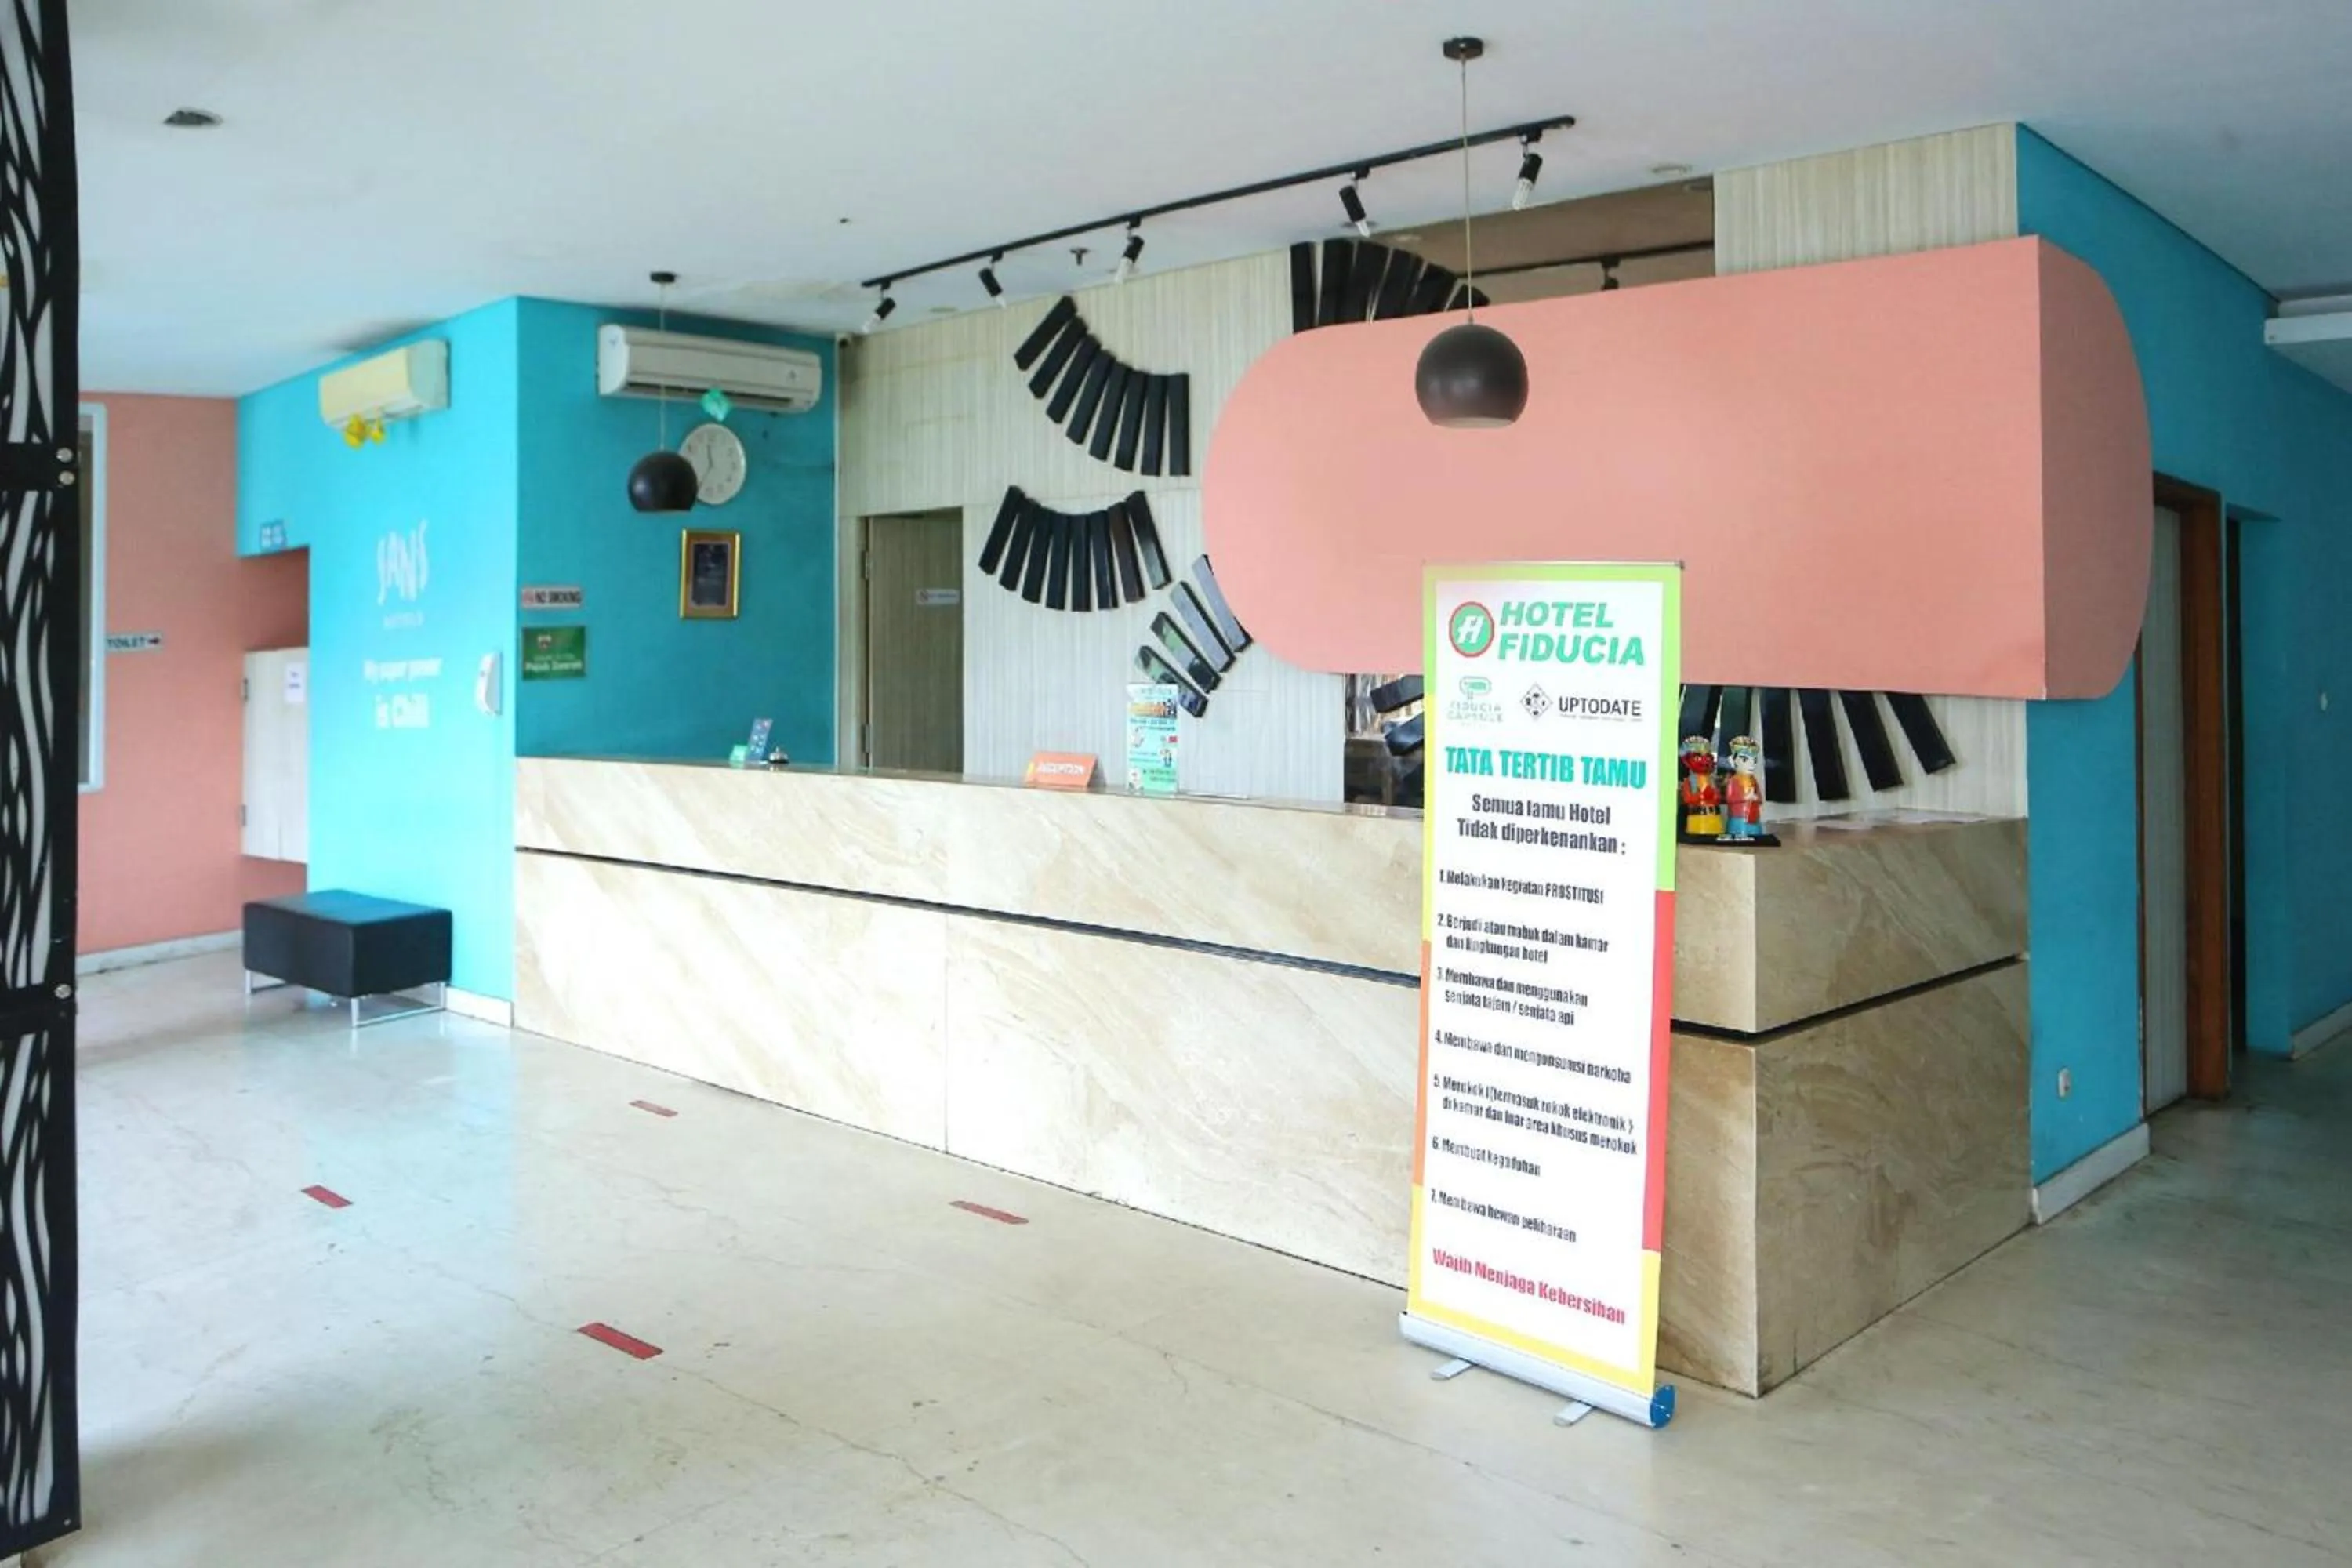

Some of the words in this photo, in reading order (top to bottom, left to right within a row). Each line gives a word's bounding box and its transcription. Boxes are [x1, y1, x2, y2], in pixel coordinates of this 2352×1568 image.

[1499, 601, 1614, 628] HOTEL
[106, 636, 146, 648] TOILET
[1497, 633, 1645, 666] FIDUCIA
[1559, 695, 1642, 717] UPTODATE
[1445, 746, 1494, 776] TATA
[1498, 750, 1574, 782] TERTIB
[1580, 755, 1646, 789] TAMU
[1472, 793, 1523, 816] Semua
[1568, 802, 1611, 825] Hotel
[1457, 818, 1498, 840] Tidak
[1501, 822, 1617, 854] diperkenankan
[1446, 869, 1500, 890] Melakukan
[1501, 877, 1544, 895] kegiatan
[1544, 882, 1604, 904] PROSTITUSI
[1483, 920, 1506, 935] atau
[1507, 924, 1540, 942] mabuk
[1541, 928, 1574, 947] dalam
[1575, 932, 1609, 952] kamar
[1515, 982, 1588, 1007] menggunakan
[1557, 1010, 1575, 1026] api
[1432, 1247, 1472, 1275] Wajib
[1475, 1261, 1535, 1296] Menjaga
[1538, 1279, 1626, 1325] Kebersihan
